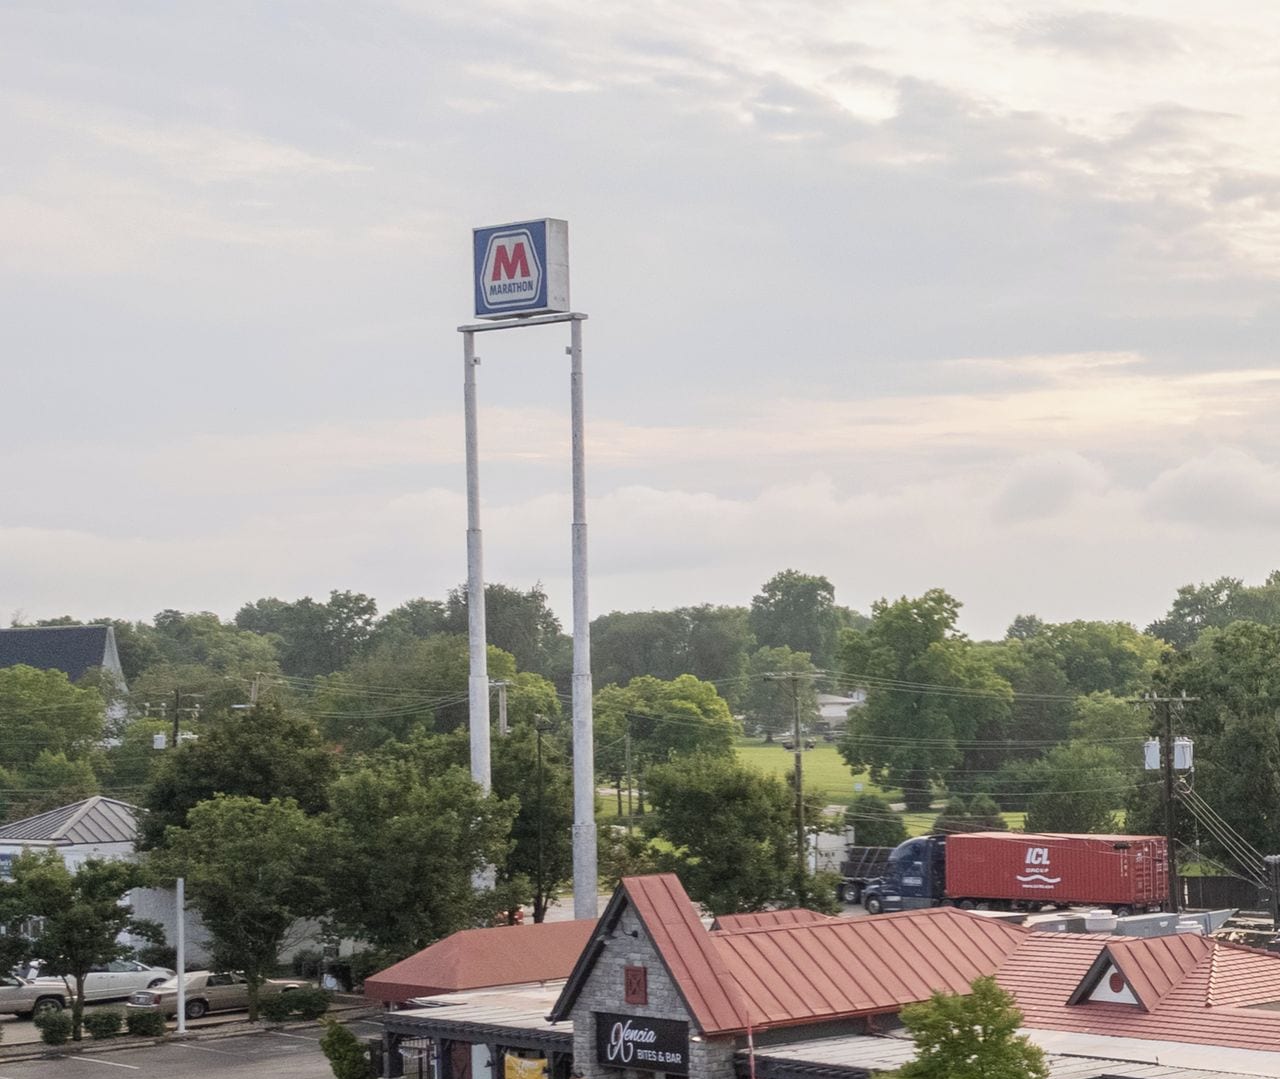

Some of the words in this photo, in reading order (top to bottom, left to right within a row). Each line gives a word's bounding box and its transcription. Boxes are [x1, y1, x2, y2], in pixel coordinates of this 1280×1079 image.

[491, 242, 531, 281] M
[489, 280, 534, 296] MARATHON
[1025, 847, 1050, 865] ICL
[607, 1020, 657, 1063] Xencia
[637, 1049, 657, 1061] BITES
[658, 1051, 665, 1062] &
[666, 1052, 682, 1064] BAR
